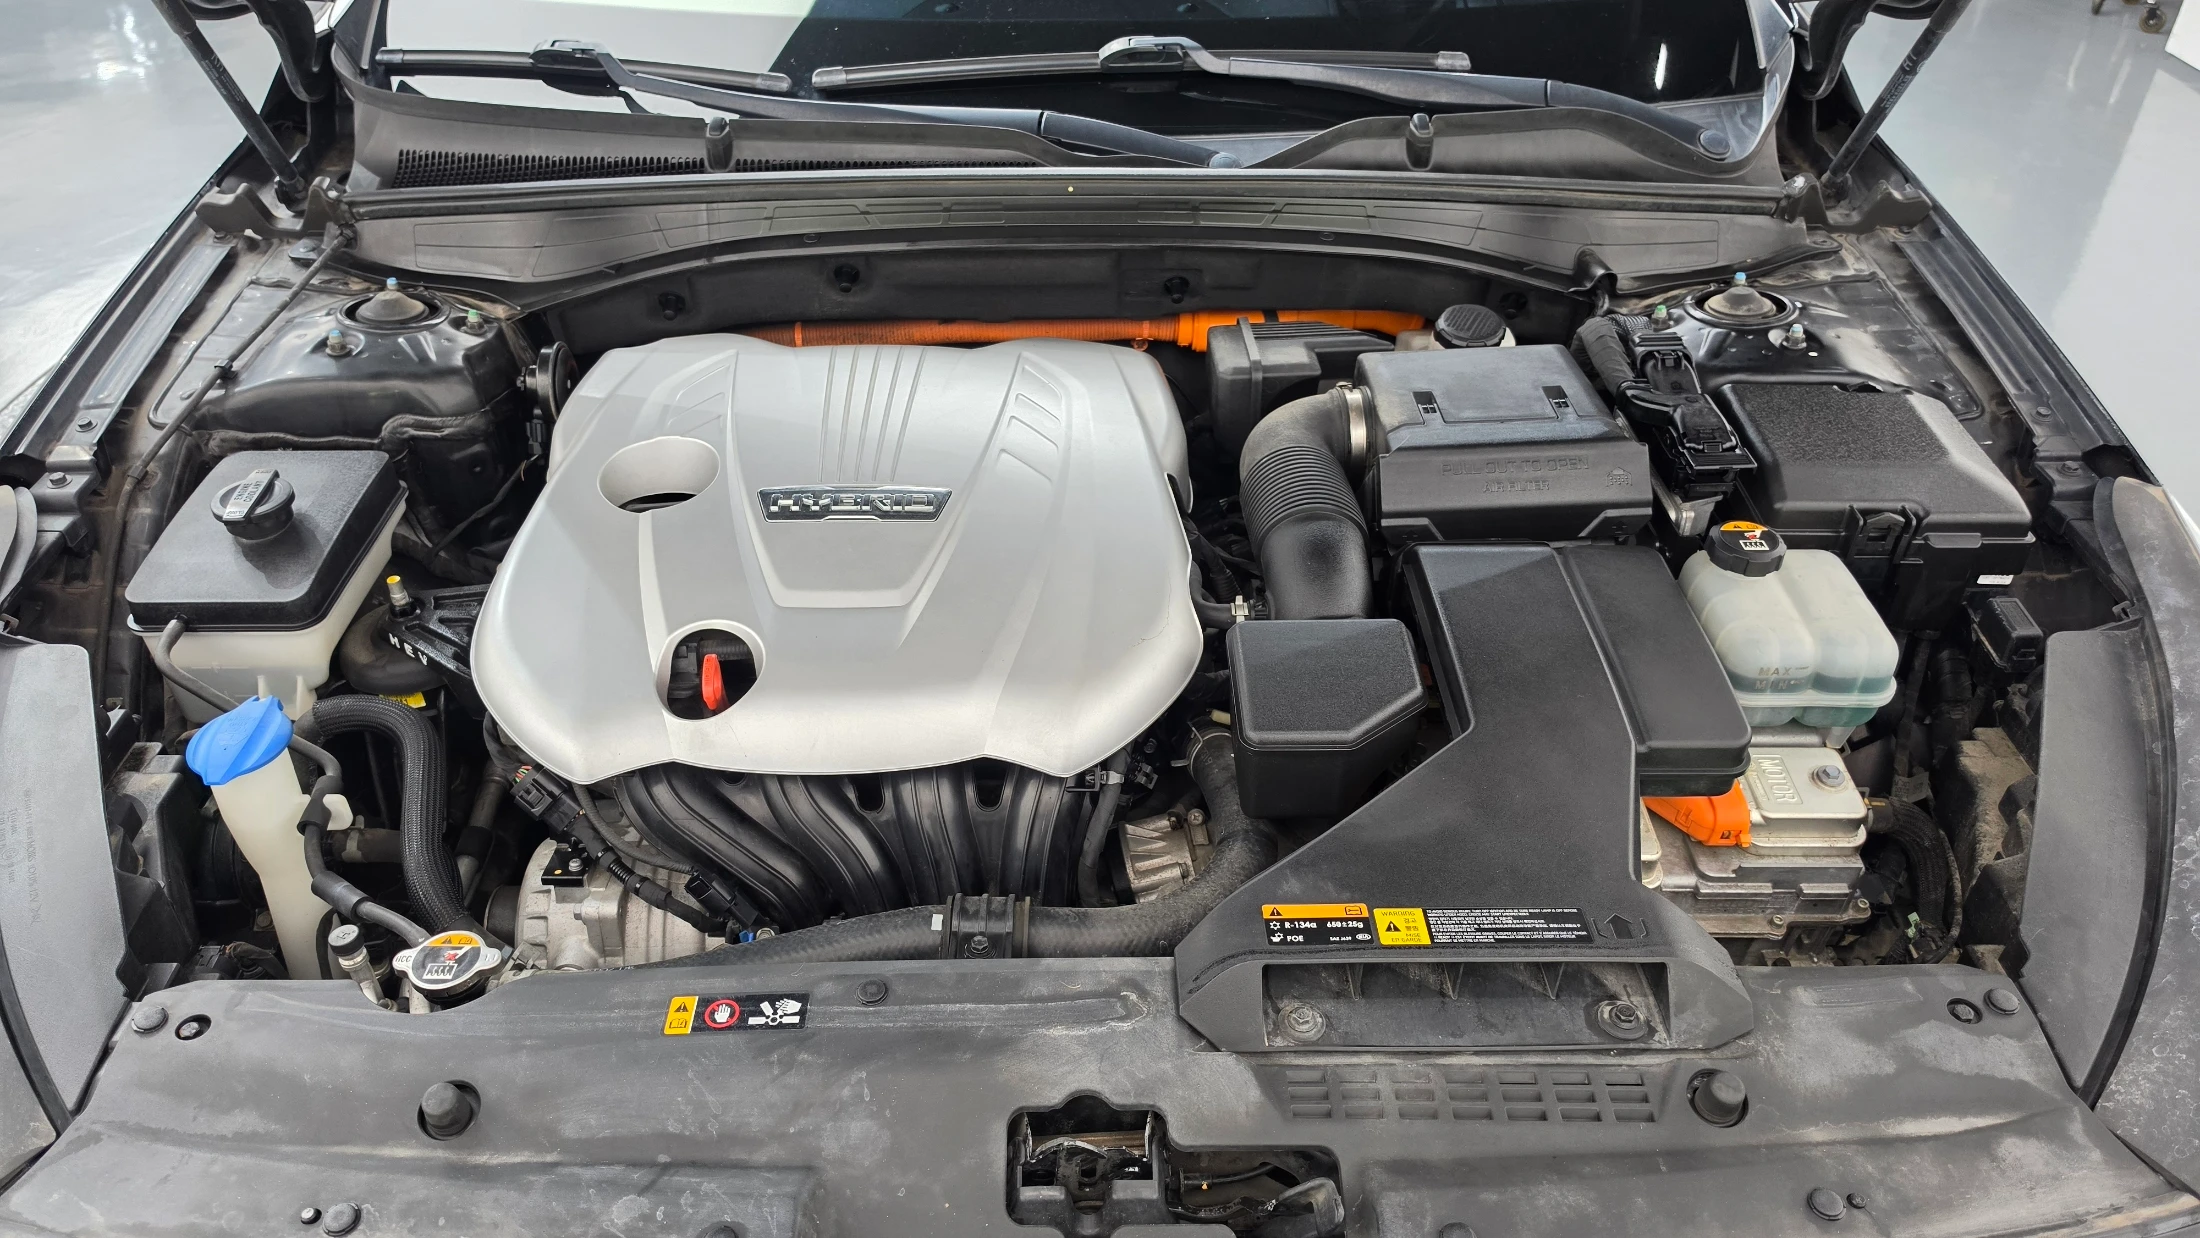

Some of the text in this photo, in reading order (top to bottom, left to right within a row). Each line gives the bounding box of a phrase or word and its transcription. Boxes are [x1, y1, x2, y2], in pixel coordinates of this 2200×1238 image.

[1441, 456, 1590, 476] PULL OUT TO OPEN
[1482, 480, 1550, 493] AIR FILTER
[769, 493, 936, 513] HYBRID
[1758, 667, 1792, 676] MAX
[1754, 680, 1790, 689] MIN
[1757, 759, 1798, 802] MOTOR
[1284, 921, 1317, 929] R-134a
